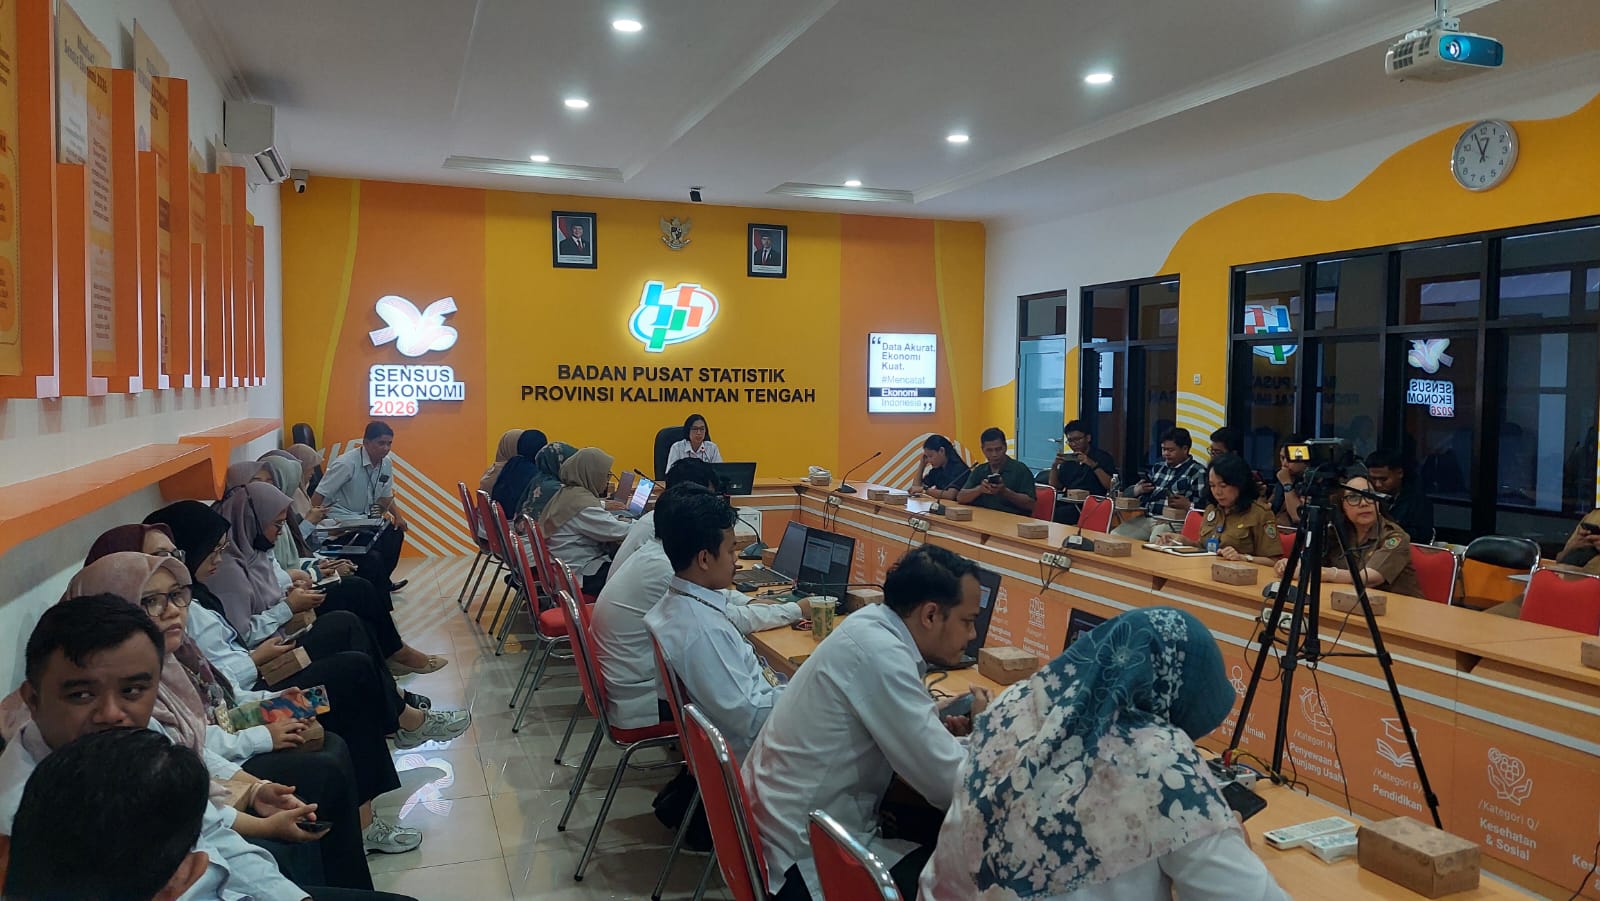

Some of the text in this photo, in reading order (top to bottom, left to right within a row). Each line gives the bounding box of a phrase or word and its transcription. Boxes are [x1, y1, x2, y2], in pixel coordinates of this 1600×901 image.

[882, 343, 902, 351] Data
[882, 352, 921, 360] Ekonomi
[882, 362, 904, 370] Kuat.
[374, 369, 450, 382] SENSUS
[558, 365, 785, 383] BADAN PUSAT STATISTIK
[882, 376, 925, 384] #Mencatat
[375, 384, 463, 397] EKONOMI
[522, 386, 816, 402] PROVINSI KALIMANTAN TENGAH
[882, 388, 918, 397] Ekonomi
[374, 401, 415, 414] 2026
[1289, 742, 1332, 766] Penyewaan
[1373, 768, 1410, 788] /Kategori
[1373, 784, 1422, 812] Pendidikan
[1478, 800, 1539, 831] /Kategori Q/
[1480, 818, 1536, 848] Kesehatan
[1485, 835, 1529, 860] & Sosial
